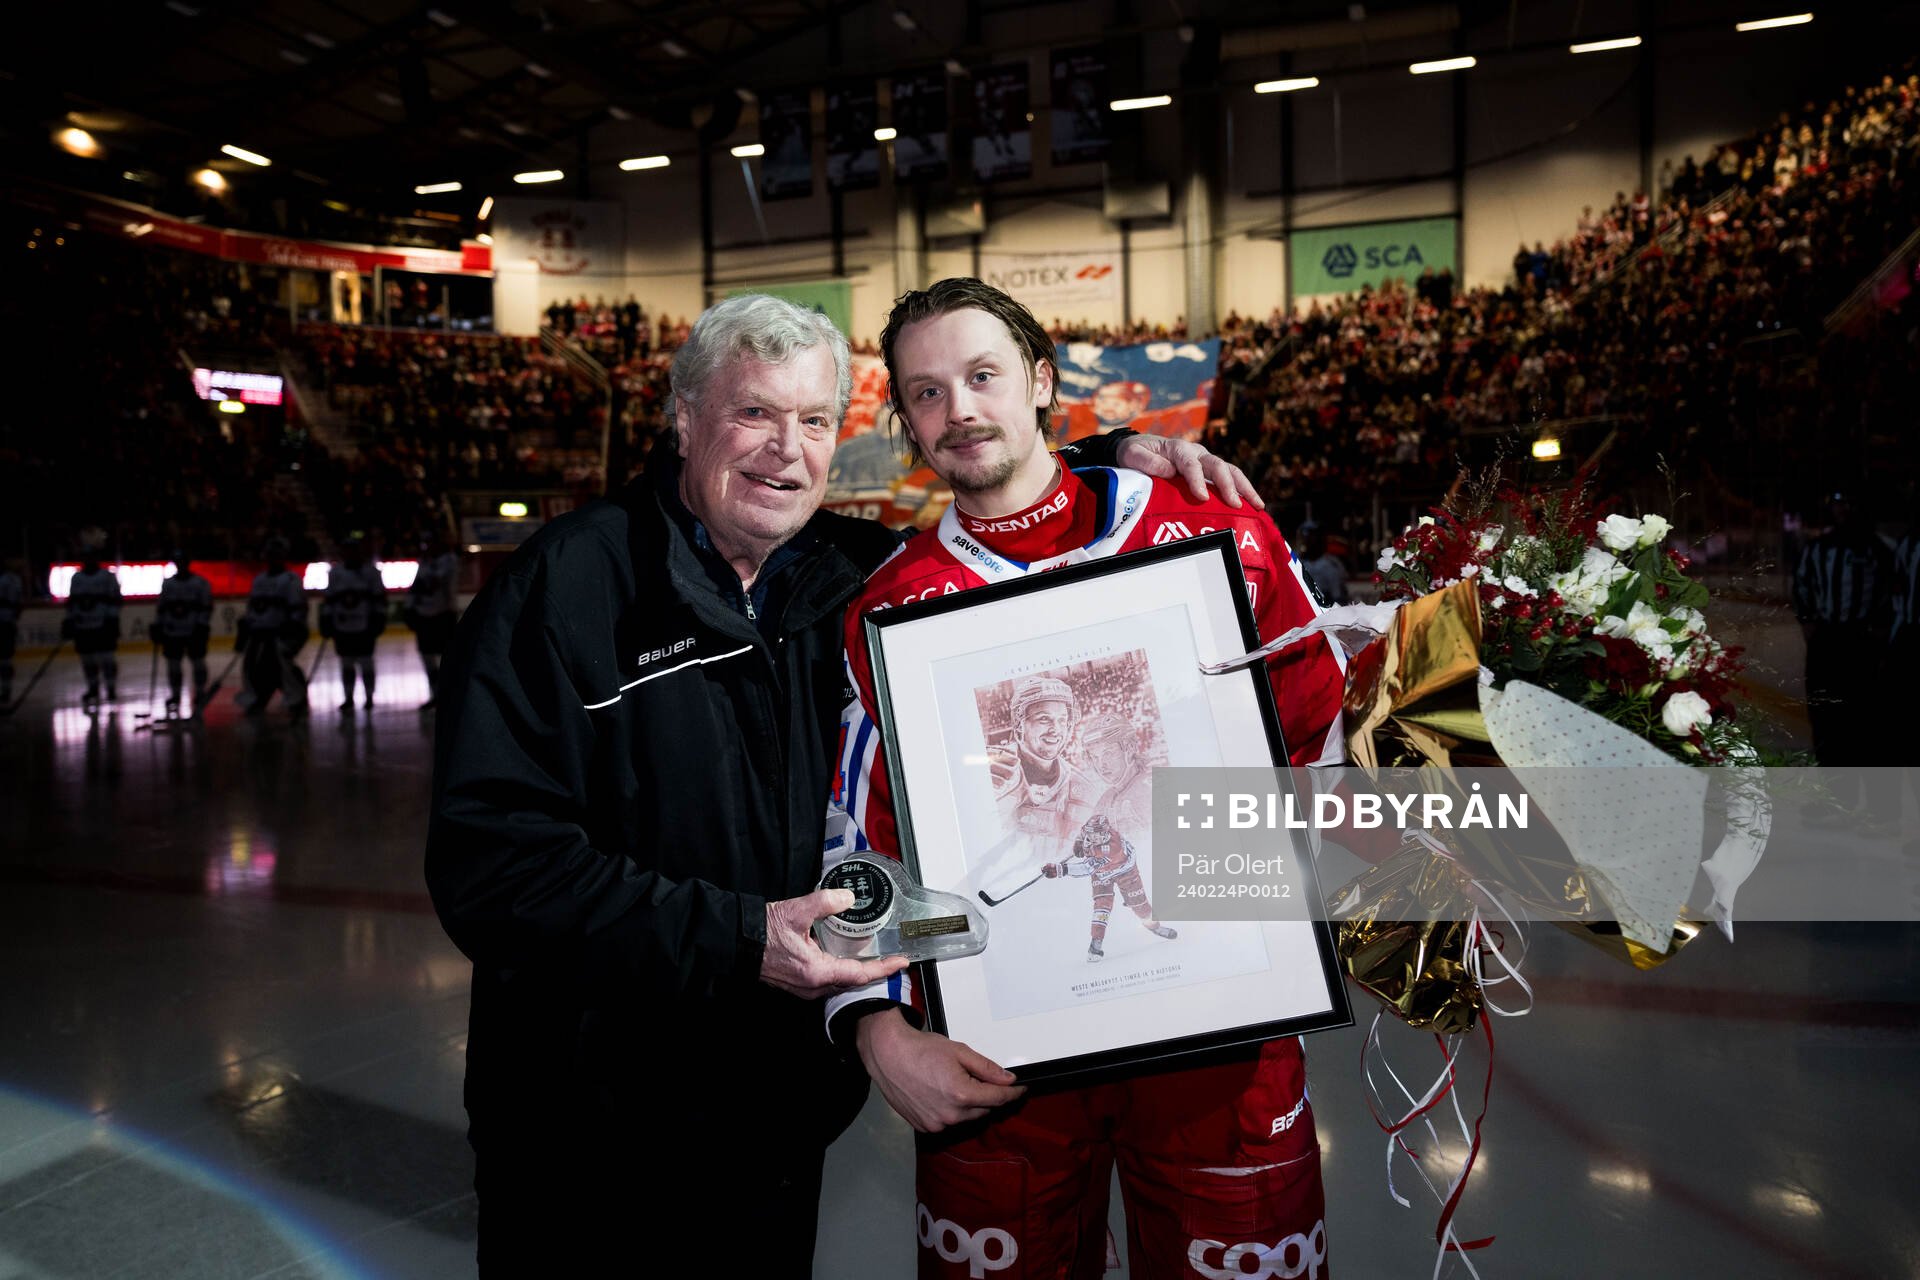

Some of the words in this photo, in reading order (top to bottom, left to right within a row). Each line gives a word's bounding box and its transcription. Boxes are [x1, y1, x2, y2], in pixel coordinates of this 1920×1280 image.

[1365, 244, 1423, 269] SCA
[988, 266, 1070, 288] NOTEX
[971, 490, 1069, 533] SVENTAB
[952, 534, 1004, 574] savecore
[841, 864, 864, 873] SHL
[916, 1201, 1019, 1280] oop
